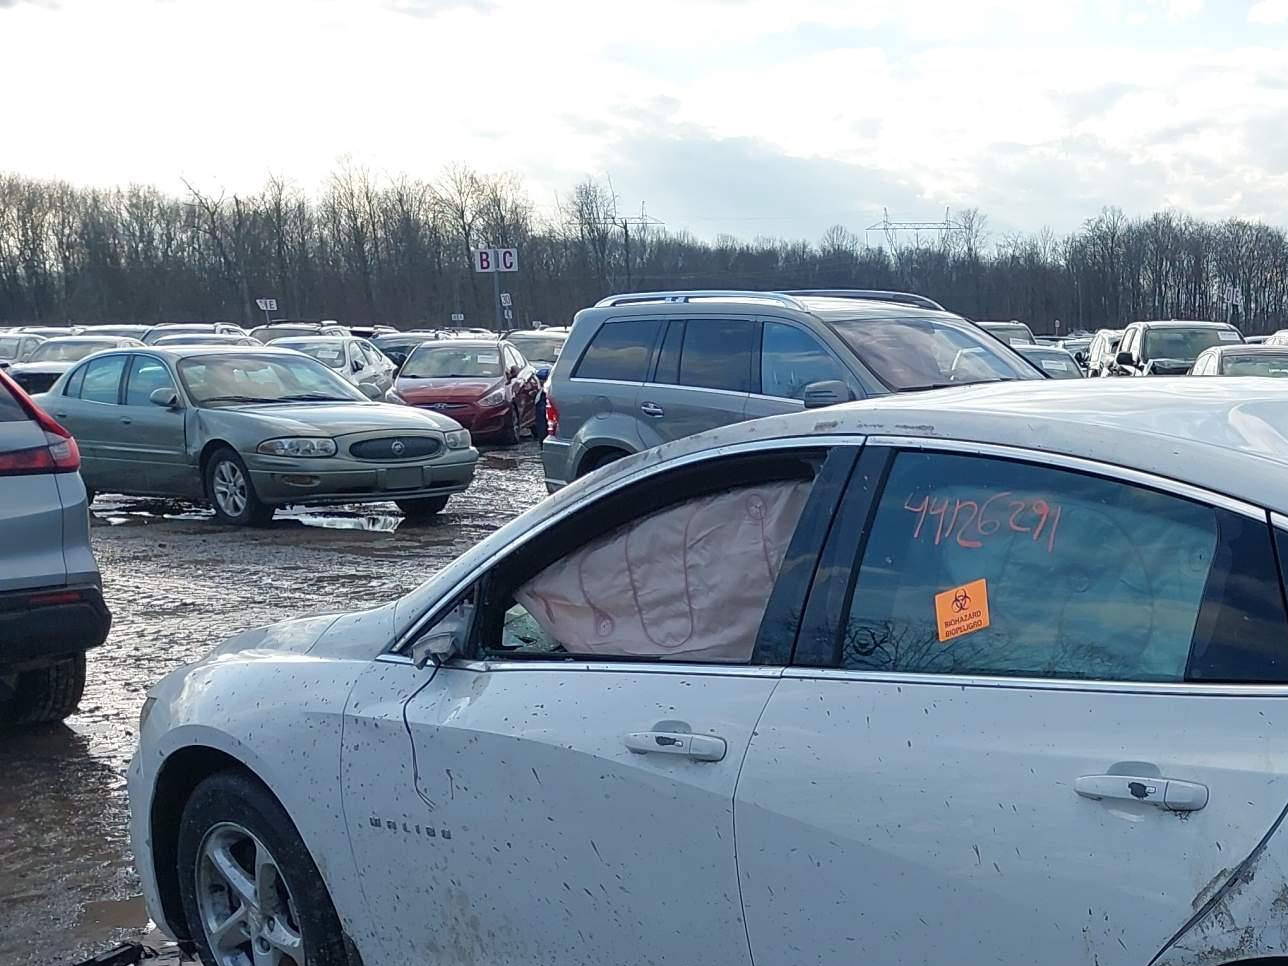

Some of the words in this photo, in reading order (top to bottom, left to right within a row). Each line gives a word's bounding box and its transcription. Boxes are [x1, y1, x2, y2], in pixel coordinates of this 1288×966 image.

[479, 251, 491, 270] B
[502, 250, 513, 269] C
[904, 491, 1062, 553] 44126291
[944, 610, 982, 628] BIOHAZARD
[368, 816, 453, 840] MALIBU
